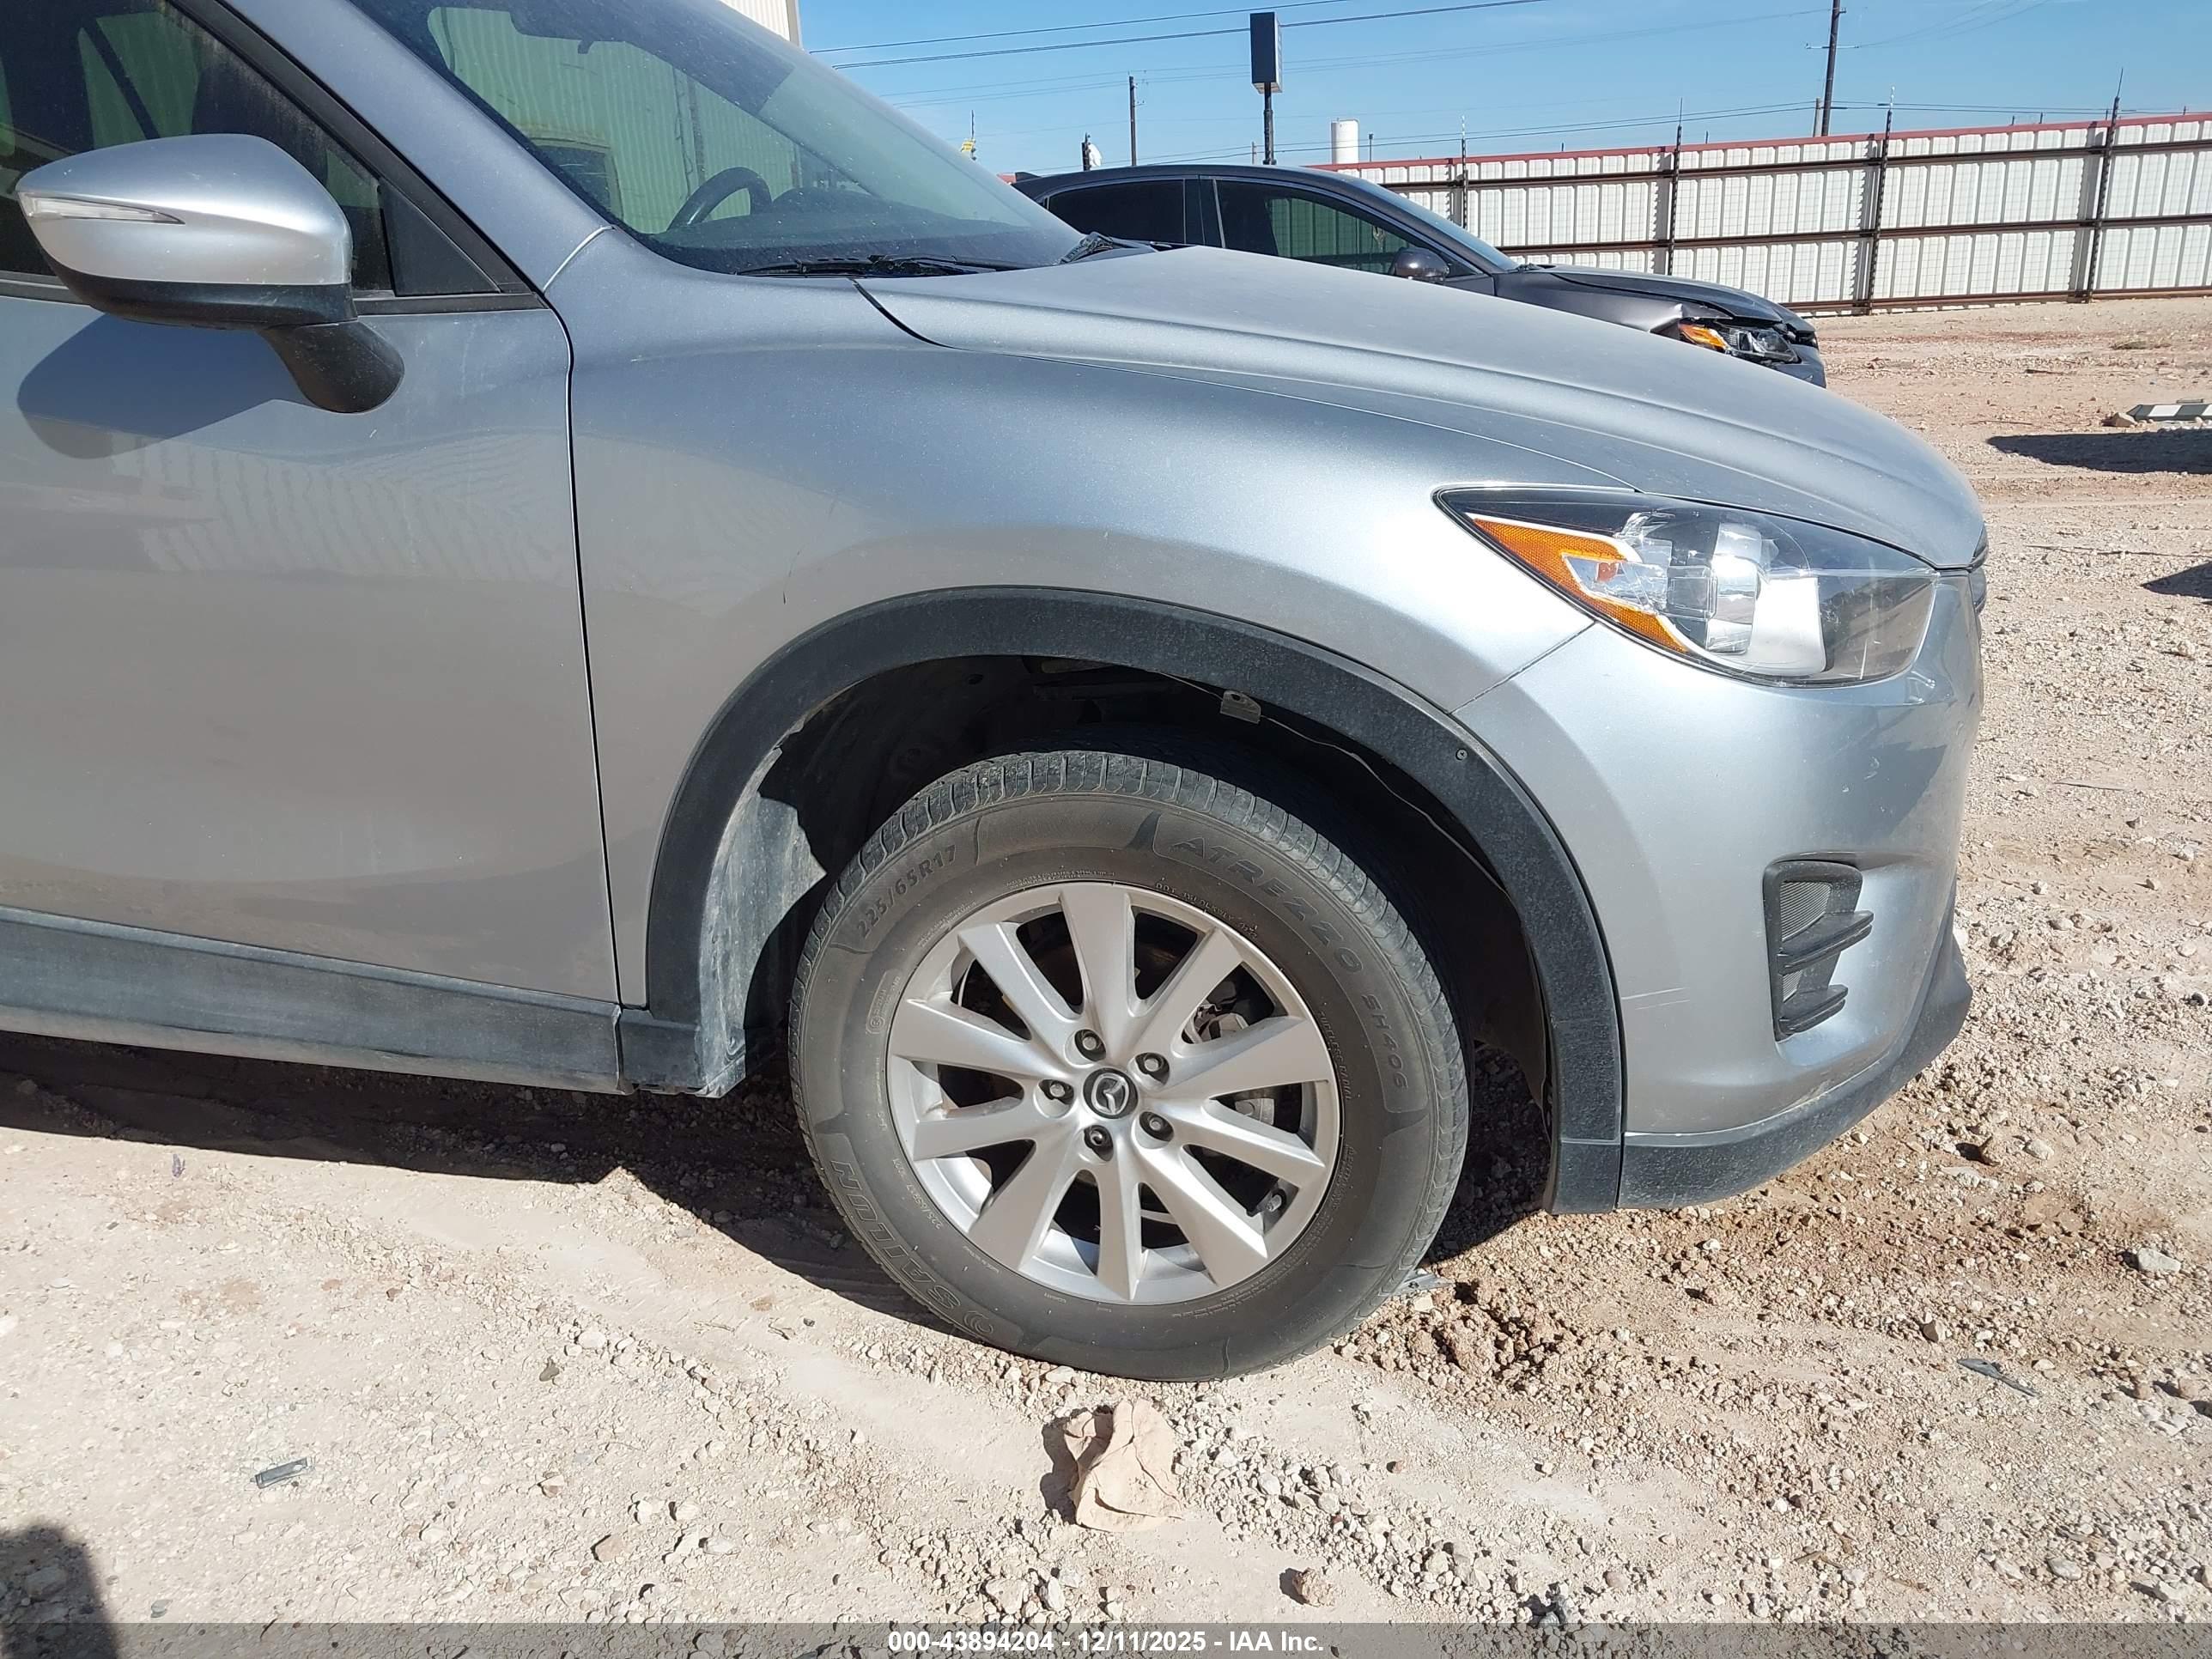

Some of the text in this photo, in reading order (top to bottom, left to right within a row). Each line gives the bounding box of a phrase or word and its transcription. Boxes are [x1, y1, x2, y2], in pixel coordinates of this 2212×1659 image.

[857, 844, 957, 939] 225/65R17
[1169, 836, 1364, 973] ATREZZO
[830, 1160, 961, 1309] SAILUN
